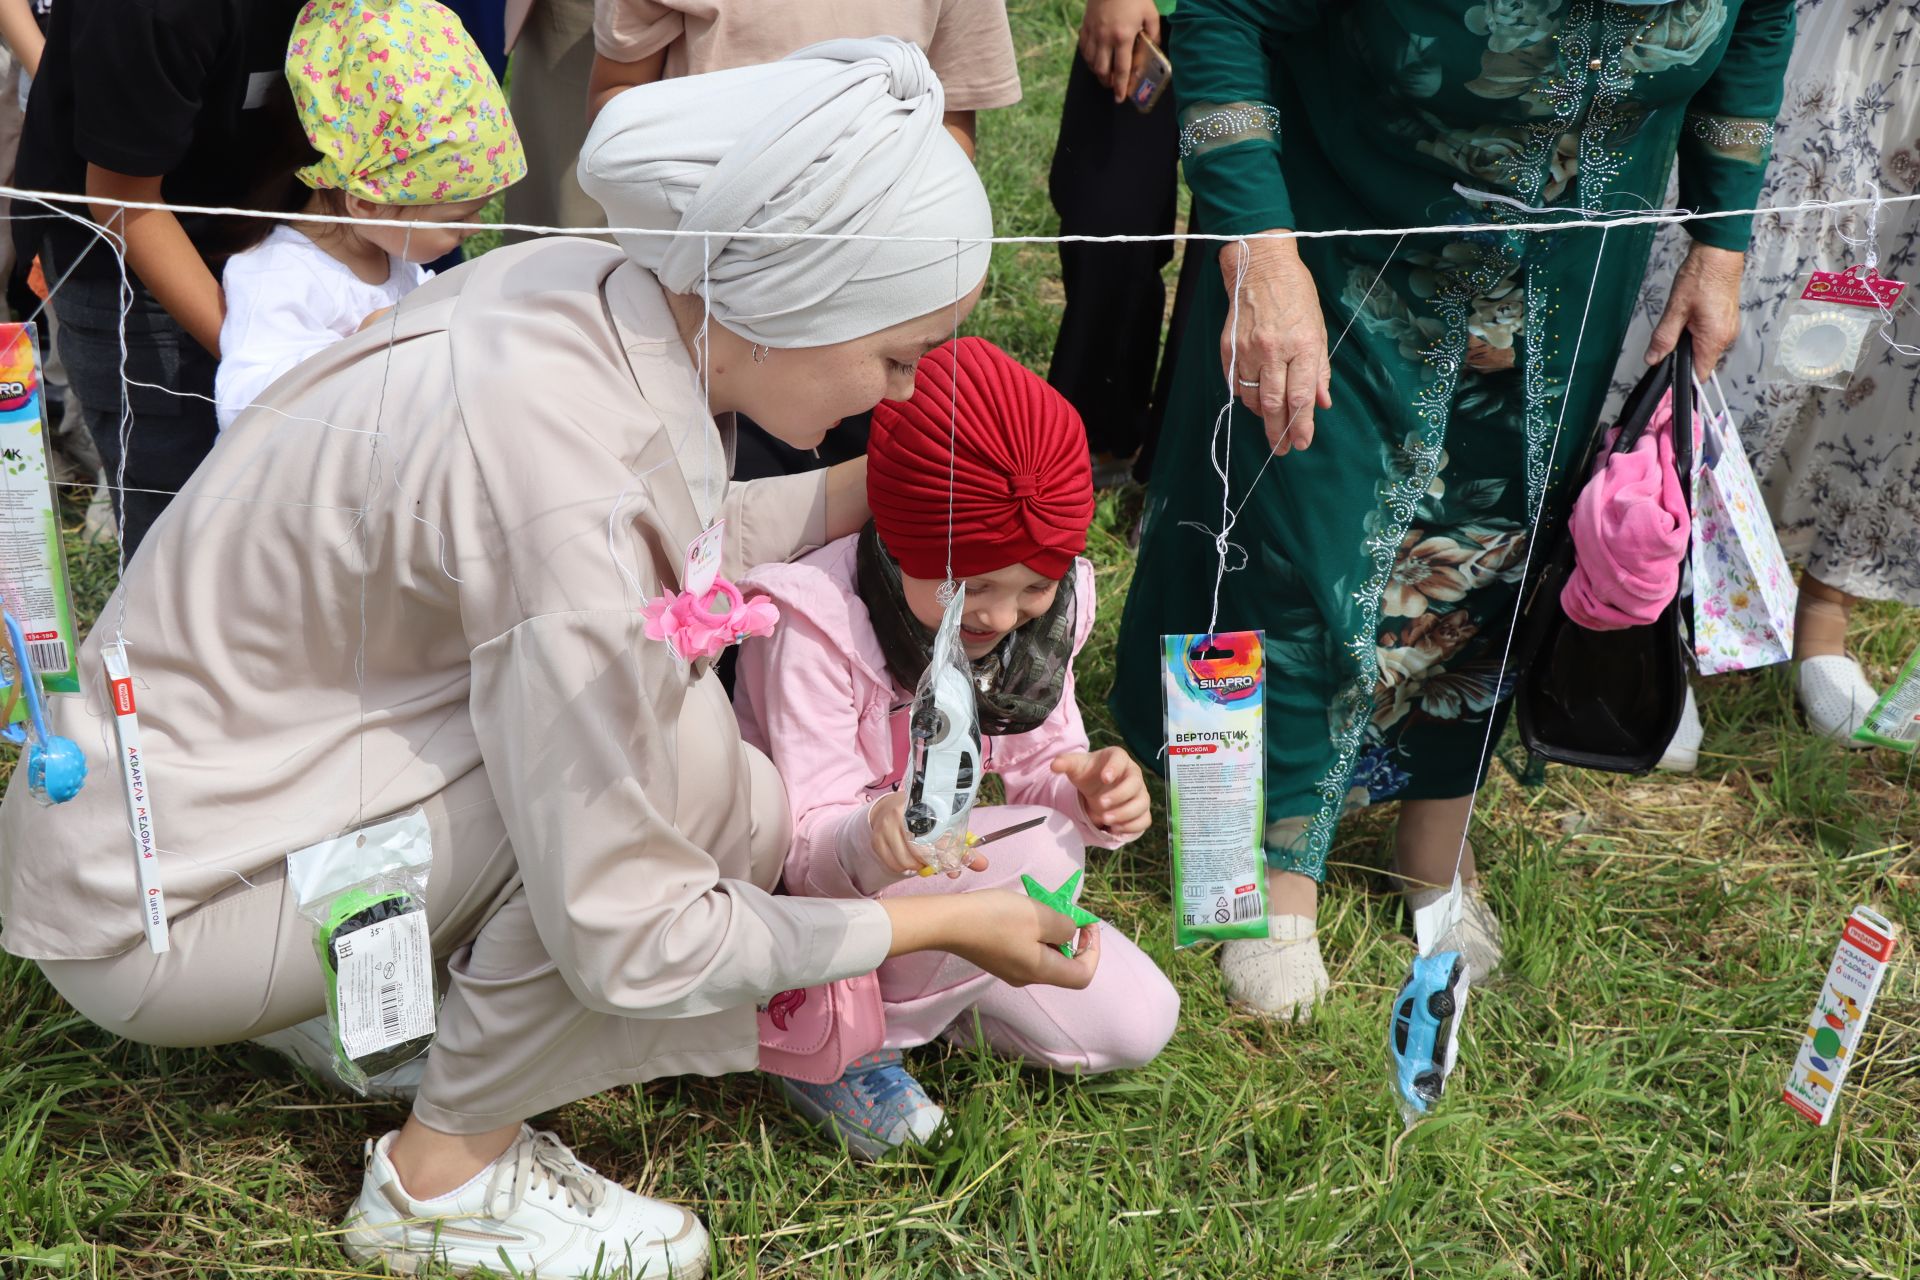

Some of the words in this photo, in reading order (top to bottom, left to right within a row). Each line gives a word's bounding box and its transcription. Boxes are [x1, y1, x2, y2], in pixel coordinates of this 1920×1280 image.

[1200, 677, 1252, 689] SILAPRO
[1176, 730, 1247, 742] ВЕРТОЛЕТИК
[128, 747, 143, 802] АКВАРЕЛЬ
[137, 807, 153, 858] МЕДОВАЯ
[150, 897, 160, 926] ЦВЕТОВ
[1836, 965, 1842, 974] 6
